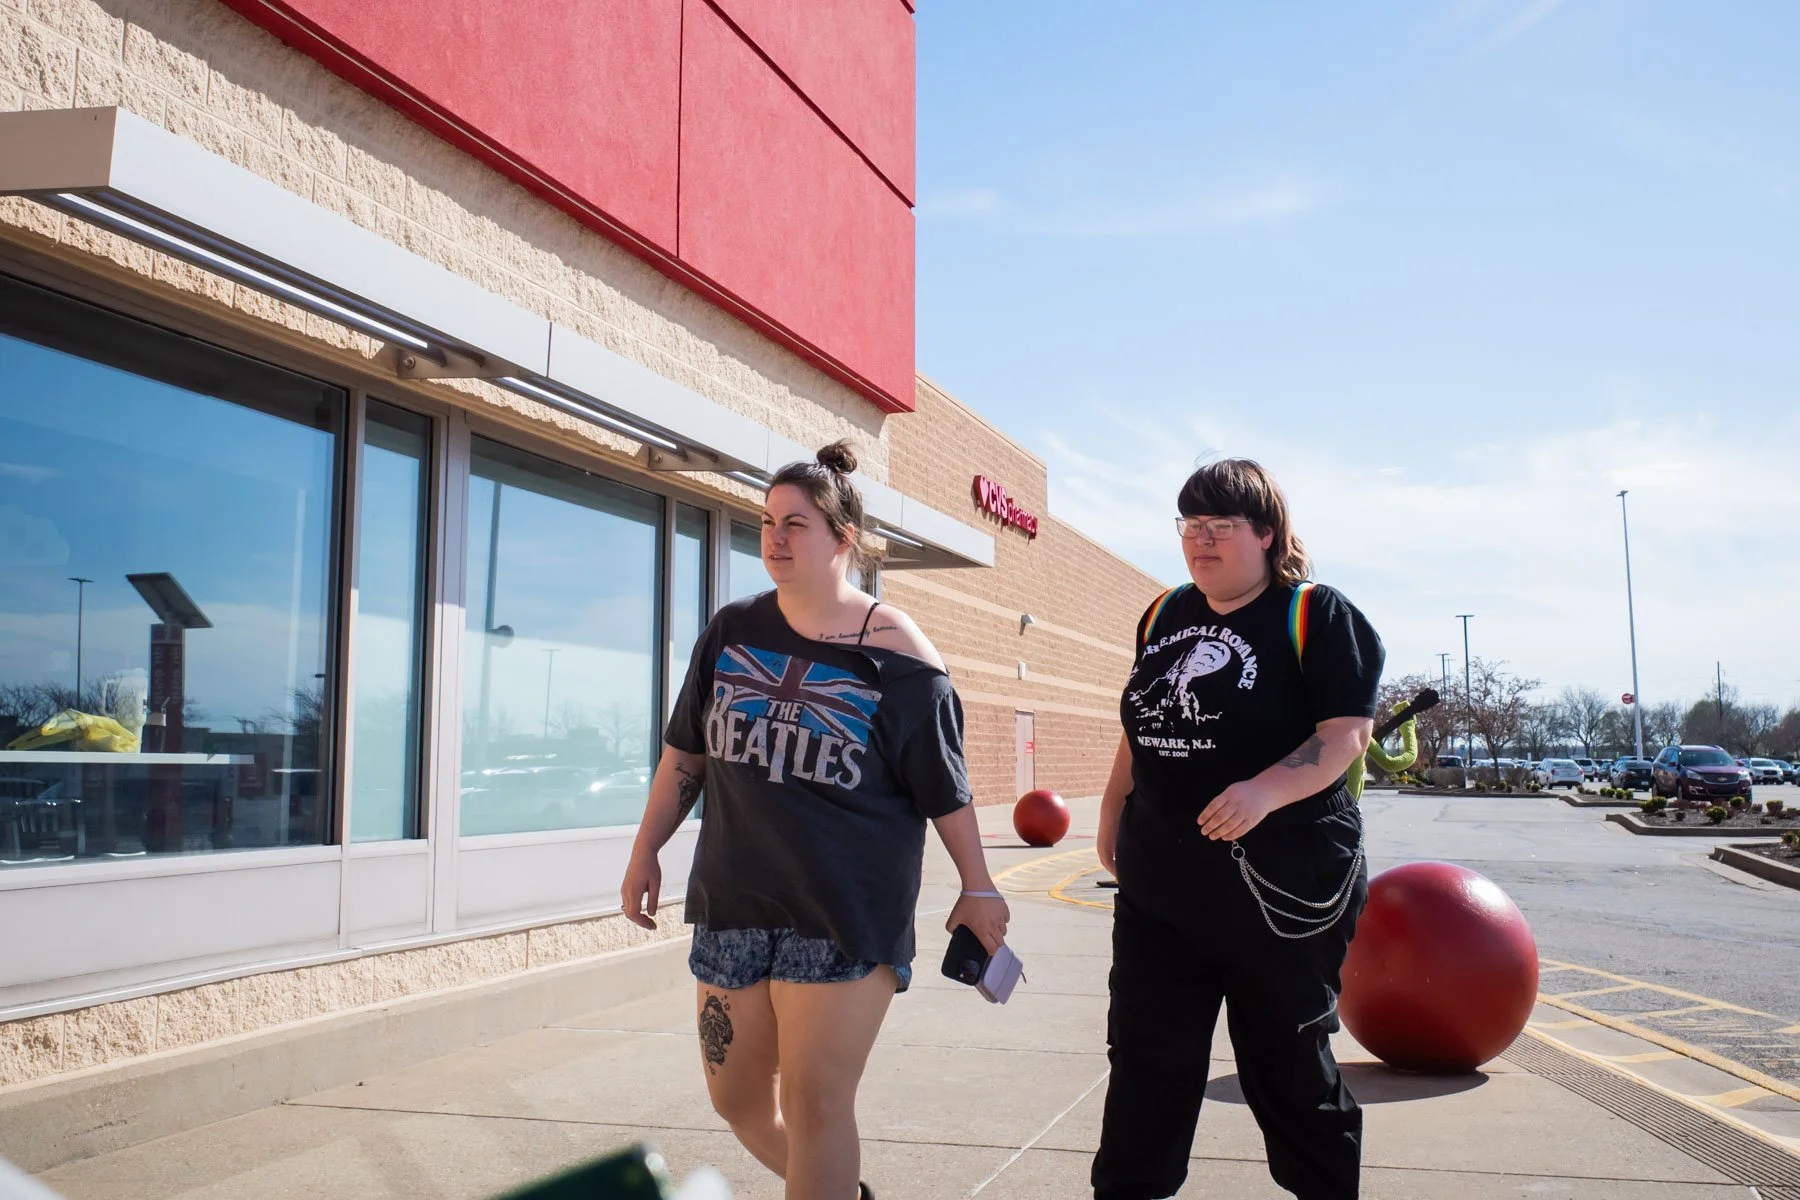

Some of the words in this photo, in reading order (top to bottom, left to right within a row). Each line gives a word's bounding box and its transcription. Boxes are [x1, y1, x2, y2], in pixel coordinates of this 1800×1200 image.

[989, 481, 1007, 518] CVS
[1218, 627, 1258, 690] ROMANCE
[769, 700, 802, 721] THE
[707, 681, 867, 790] BEATLES
[1137, 735, 1190, 750] NEWARK,
[1192, 738, 1216, 750] N.J.
